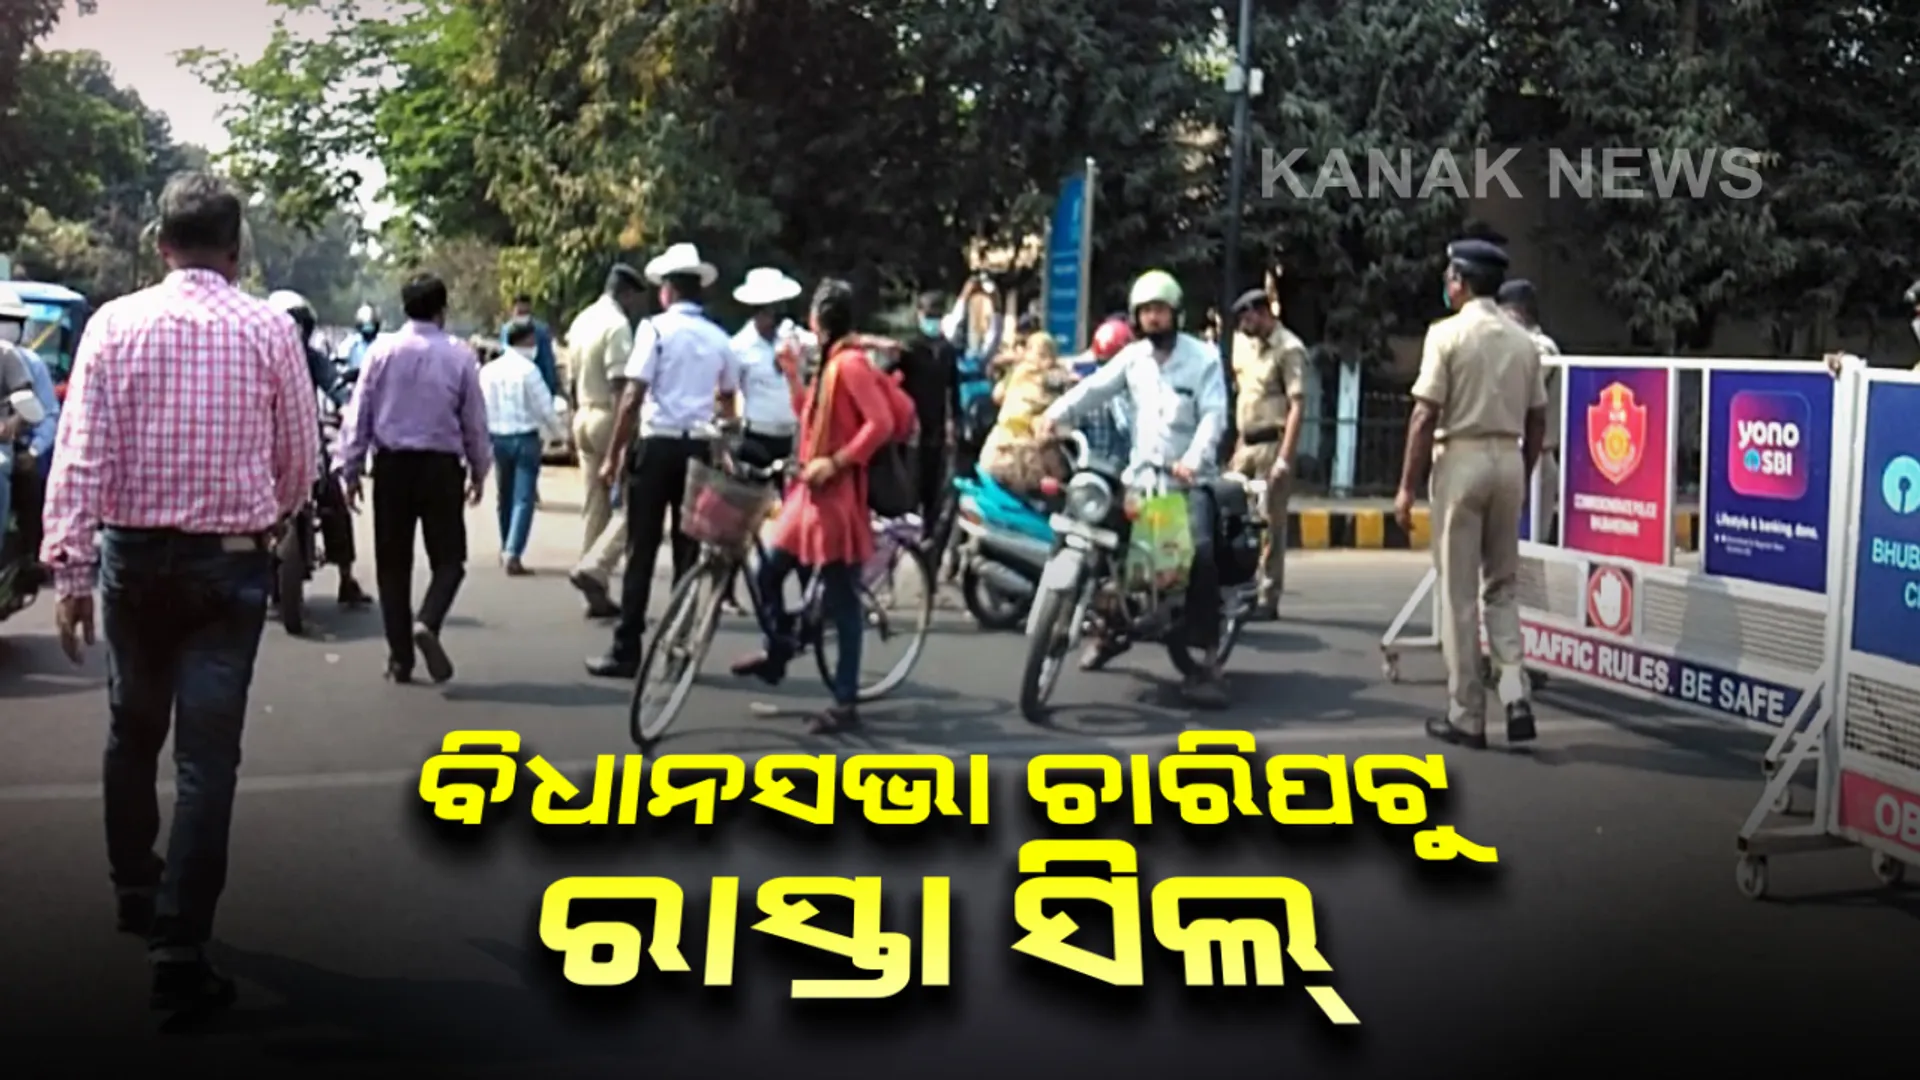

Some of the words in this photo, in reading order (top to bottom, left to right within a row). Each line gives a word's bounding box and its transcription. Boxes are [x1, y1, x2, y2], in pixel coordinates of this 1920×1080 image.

[1737, 419, 1800, 449] yono
[1761, 449, 1793, 477] SBI
[1598, 644, 1675, 695] RULES.
[1680, 667, 1714, 704] BE
[1718, 676, 1785, 725] SAFE
